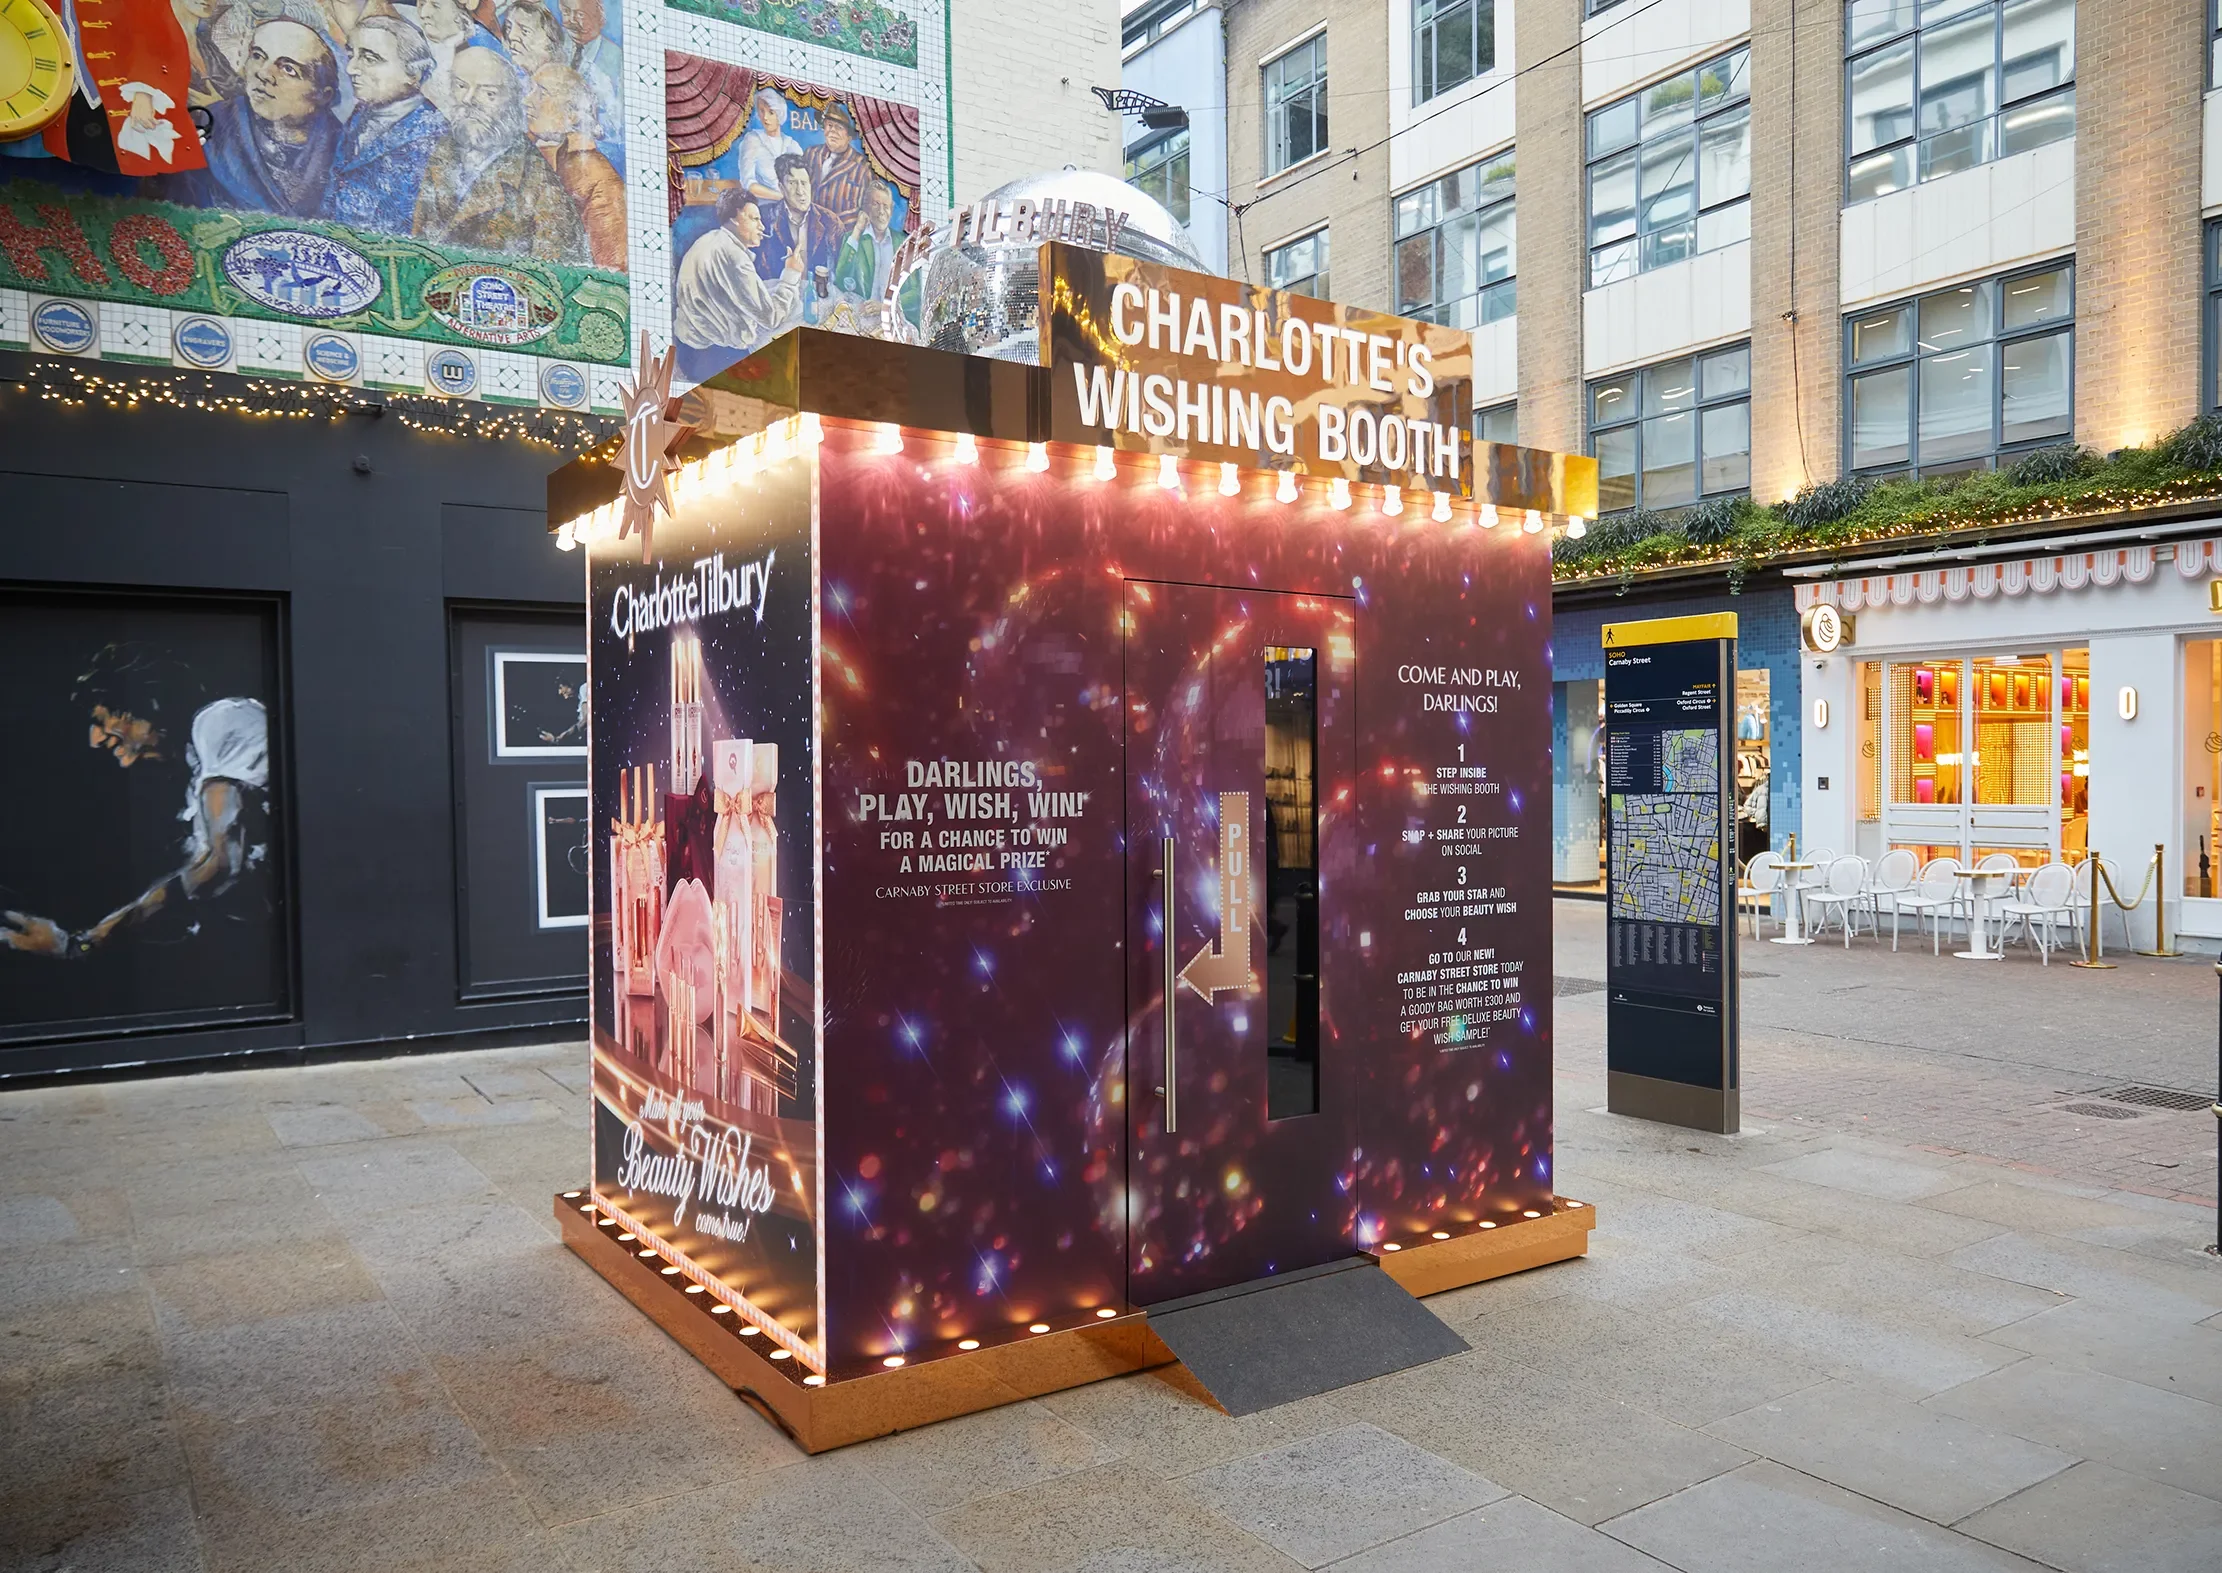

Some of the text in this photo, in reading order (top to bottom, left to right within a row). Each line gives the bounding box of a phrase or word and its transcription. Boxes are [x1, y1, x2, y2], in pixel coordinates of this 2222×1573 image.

[949, 198, 1129, 253] TILBURY
[476, 289, 509, 301] STREET
[447, 318, 511, 344] ALTERNATIVE
[516, 328, 540, 342] ARTS
[1111, 282, 1433, 398] CHARLOTTE'S
[1073, 361, 1460, 480] WISHING BOOTH
[1608, 651, 1626, 659] SOHO
[1608, 657, 1652, 667] Carnaby Street
[1398, 665, 1521, 691] COME AND PLAY,
[1423, 693, 1498, 713] DARLINGS!
[1457, 743, 1466, 762] 1
[907, 760, 1043, 792] DARLINGS,
[1436, 767, 1458, 779] STEP
[1439, 783, 1473, 795] WISHING
[1474, 782, 1500, 794] BOOTH
[859, 791, 1084, 826] PLAY, WISH, WIN!
[1457, 804, 1467, 824] 2
[880, 827, 1068, 850] FOR A CHANCE TO WIN
[1436, 828, 1464, 840] SHARE
[1466, 828, 1487, 840] YOUR
[1488, 827, 1519, 838] PICTURE
[1441, 844, 1482, 856] ON SOCIAL
[899, 855, 913, 873] A
[919, 852, 995, 872] MAGICAL
[1228, 823, 1242, 933] PULL
[1457, 866, 1467, 885] 3
[875, 878, 1073, 899] CARNABY STREET STORE EXCLUSIVE
[1417, 887, 1506, 904] GRAB YOUR STAR AND
[1404, 902, 1517, 921] CHOOSE YOUR BEAUTY WISH
[1457, 927, 1467, 946] 4
[1428, 948, 1495, 965] GO TO OUR NEW!
[1397, 961, 1524, 984] CARNABY STREET STORE TODAY
[1403, 976, 1519, 1000] TO BE IN THE CHANCE TO WIN
[1400, 992, 1521, 1017] A GOODY BAG WORTH £300 AND
[1400, 1007, 1522, 1034] GET YOUR FREE DELUXE BEAUTY
[1433, 1031, 1453, 1045] WISH
[617, 1120, 776, 1227] Beauty Wishes
[695, 1212, 722, 1236] come
